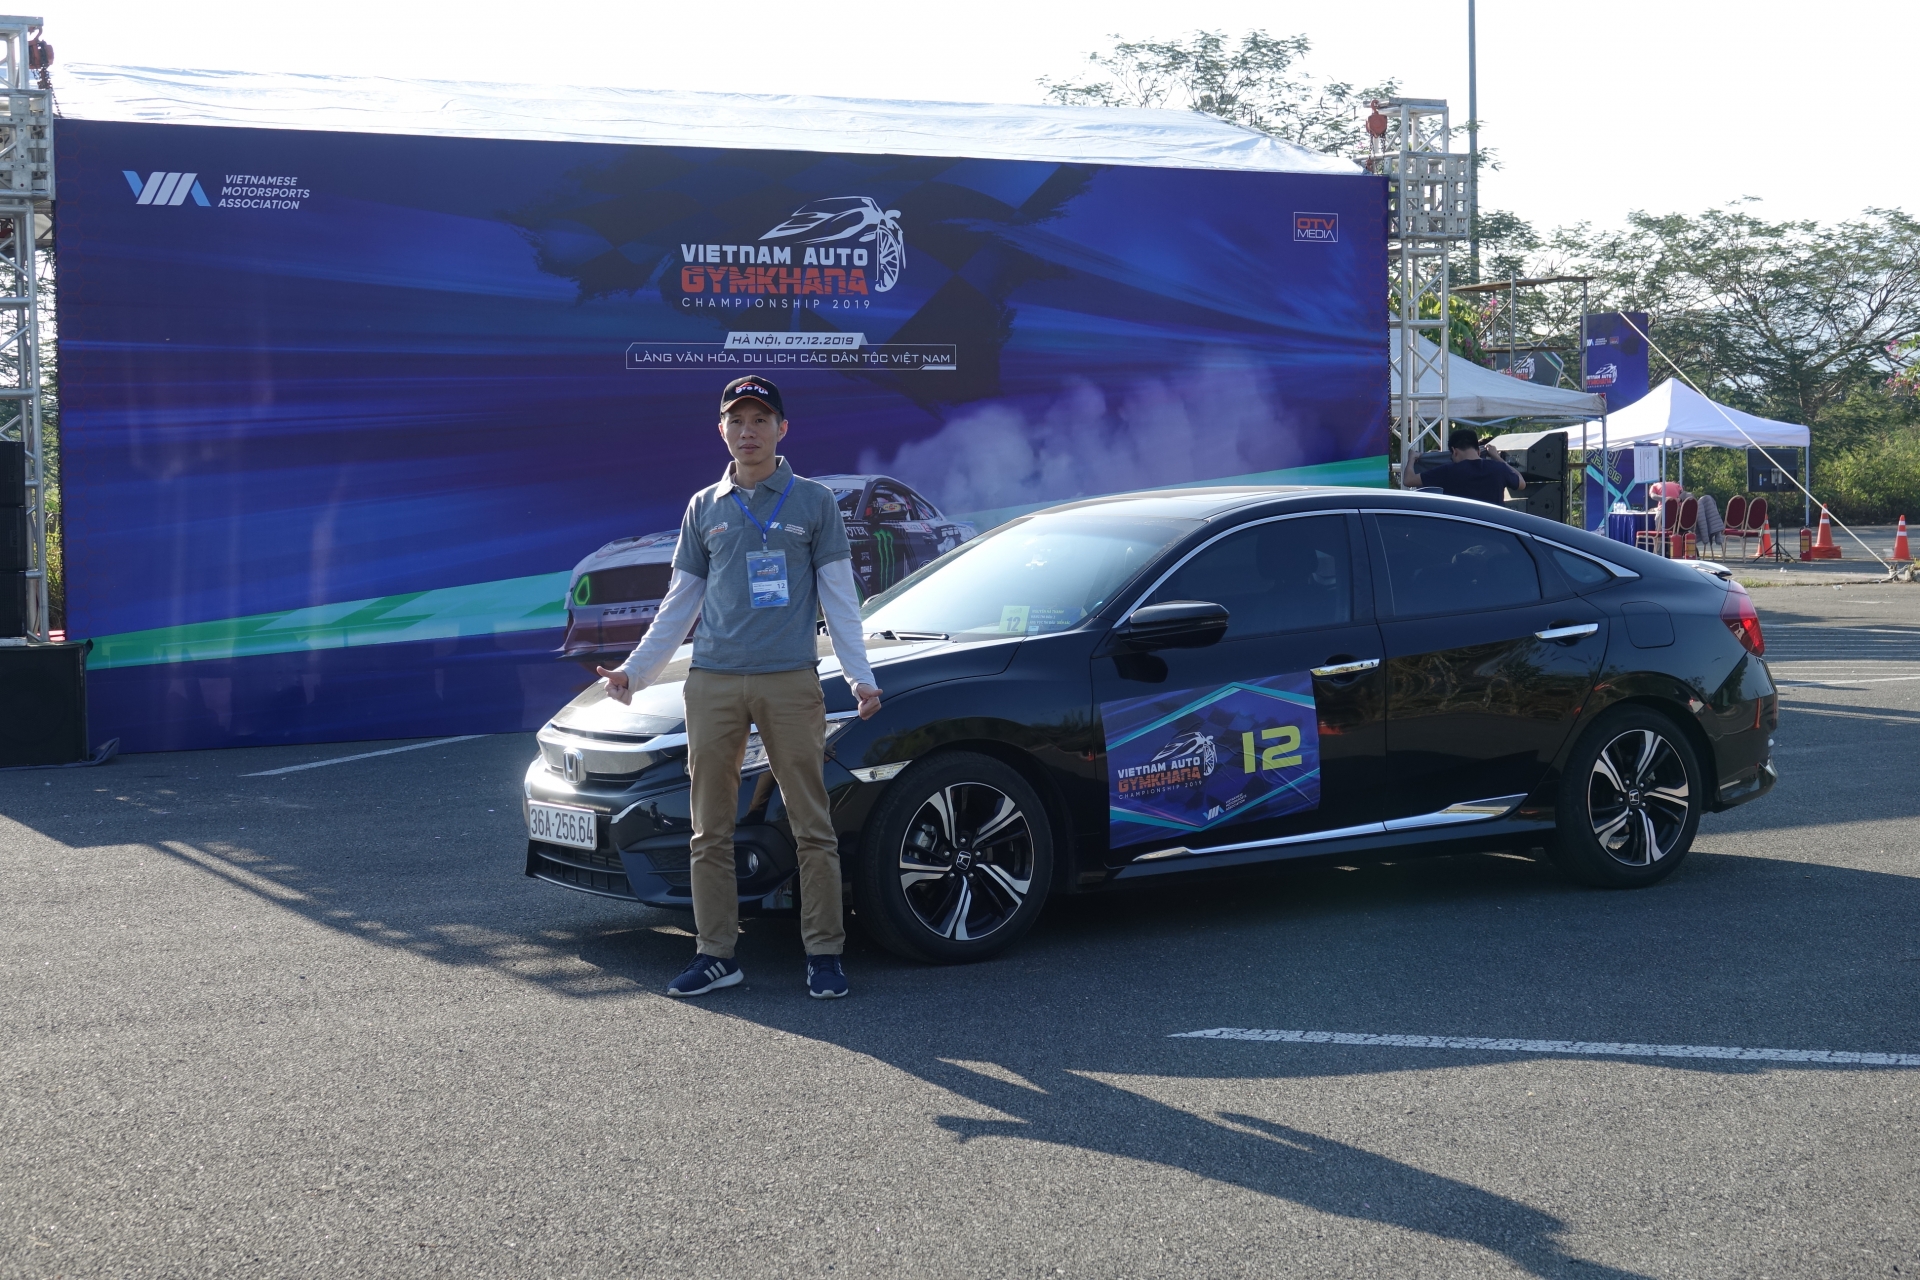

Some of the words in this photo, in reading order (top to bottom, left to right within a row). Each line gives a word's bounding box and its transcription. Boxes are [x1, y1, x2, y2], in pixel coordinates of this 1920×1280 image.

[225, 174, 298, 186] VIETNAMESE
[221, 186, 310, 199] MOTORSPORTS
[218, 198, 300, 210] ASSOCIATION
[1297, 229, 1336, 242] MEDIA
[681, 243, 791, 265] VIETNAM
[803, 247, 868, 266] AUTO
[681, 265, 869, 295] GYMKHANA
[681, 297, 821, 309] CHAMPIONSHIP
[832, 299, 870, 309] 2019
[731, 333, 751, 345] HÀ
[754, 333, 781, 347] NỘI,
[784, 336, 854, 345] 07.12.2019
[635, 350, 673, 363] LÀNG
[675, 351, 704, 363] VĂN
[707, 351, 740, 364] HÓA,
[743, 353, 762, 363] DU
[766, 353, 796, 365] LỊCH
[800, 351, 827, 363] CÁC
[831, 352, 859, 363] DÂN
[862, 352, 888, 365] TỘC
[891, 352, 919, 365] VIỆT
[922, 354, 950, 363] NAM
[777, 582, 786, 590] 12
[1006, 616, 1021, 632] 12
[1241, 725, 1303, 775] 12
[1117, 761, 1166, 779] VIETNAM
[1171, 756, 1201, 770] AUTO
[1118, 766, 1202, 793] GYMKHANA
[1118, 784, 1180, 800] CHAMPIONSHIP
[1184, 780, 1203, 788] 2019
[530, 808, 594, 845] 36A-256.64
